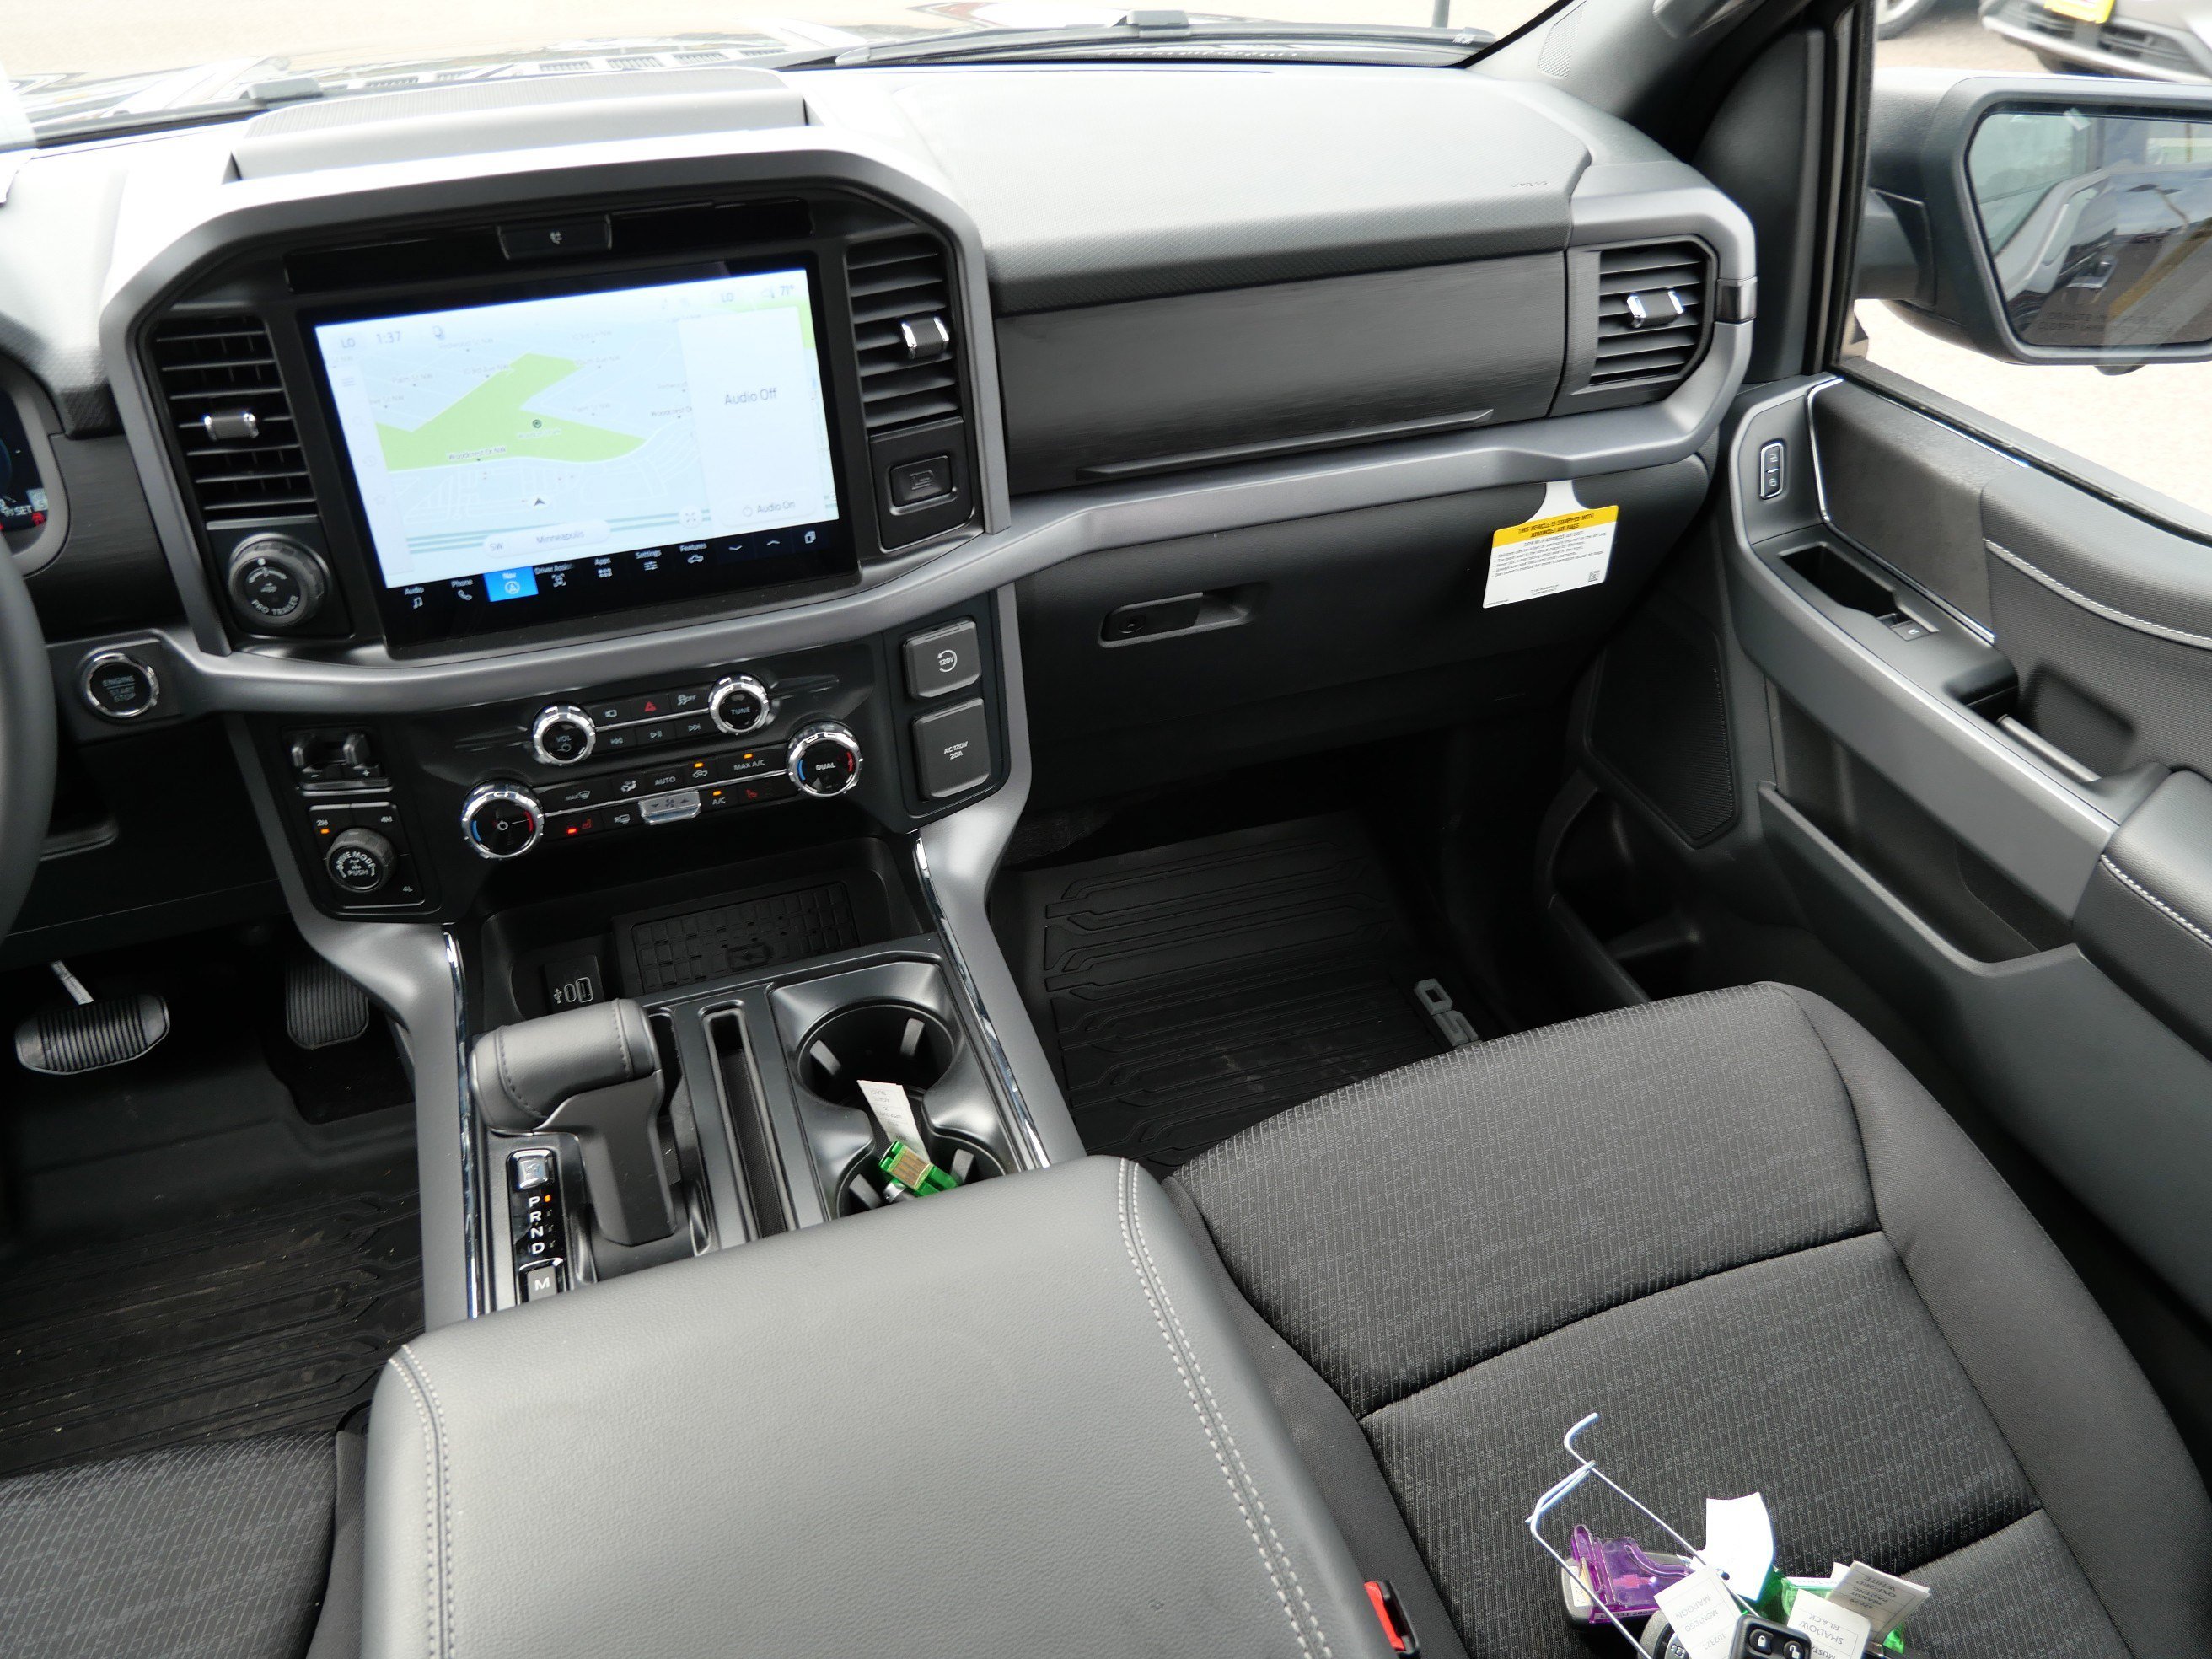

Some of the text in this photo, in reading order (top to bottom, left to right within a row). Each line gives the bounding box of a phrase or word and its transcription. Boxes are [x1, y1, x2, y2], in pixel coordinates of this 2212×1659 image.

[721, 293, 735, 303] LO
[341, 338, 356, 348] LO
[376, 331, 401, 344] 1:37
[725, 387, 777, 405] Audio Off
[757, 501, 795, 514] Audio On
[490, 530, 584, 551] SW Minneapolis
[679, 543, 707, 552] Features
[635, 549, 662, 560] Settings
[594, 558, 611, 566] Apps
[534, 566, 553, 575] Driver
[451, 578, 473, 588] Phone
[405, 586, 424, 595] Audio
[252, 599, 270, 614] PRO
[938, 656, 954, 666] 120V
[730, 706, 751, 715] TUNE
[556, 735, 572, 744] VOL
[943, 740, 969, 754] AC 120V
[949, 750, 964, 760] 20A
[733, 759, 765, 770] MAX A/C
[815, 761, 836, 771] DUAL
[655, 776, 676, 786] AUTO
[712, 797, 726, 805] A/C
[352, 851, 376, 869] MODE
[529, 1196, 545, 1254] P R N D
[534, 1276, 550, 1291] M
[1855, 1579, 1897, 1597] OXFORD
[1864, 1576, 1896, 1590] WHITE
[1850, 1592, 1882, 1605] TRANSIT
[1675, 1595, 1711, 1620] MAROON
[1684, 1608, 1718, 1632] MONTEGO
[1809, 1613, 1841, 1631] BLACK
[1799, 1620, 1844, 1645] SHADOW
